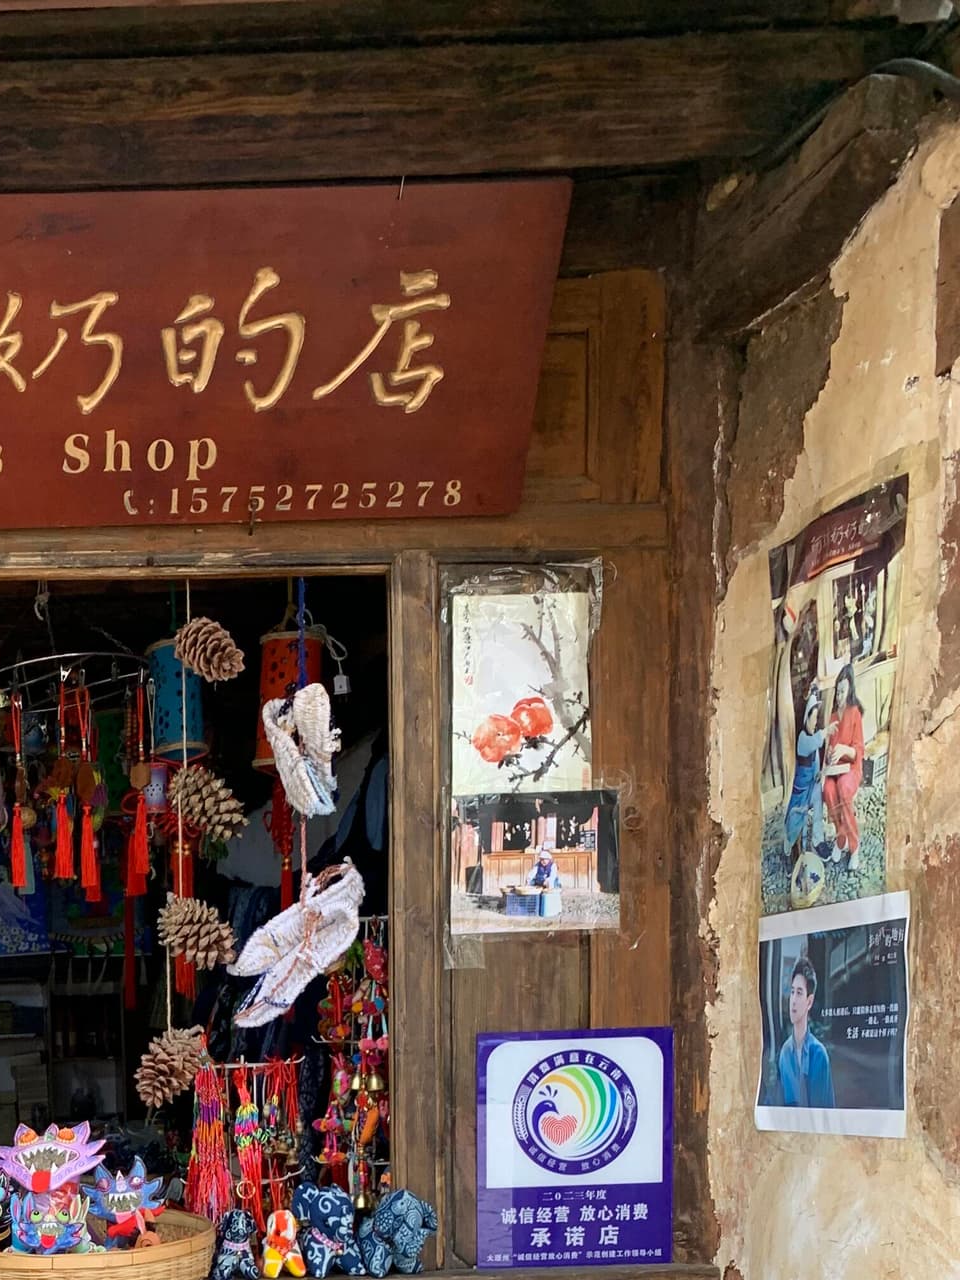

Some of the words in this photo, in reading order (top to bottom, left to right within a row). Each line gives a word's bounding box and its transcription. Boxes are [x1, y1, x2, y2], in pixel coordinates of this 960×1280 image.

[63, 430, 219, 481] Shop
[501, 1205, 571, 1224] 诚信经营
[579, 1203, 649, 1222] 放心消费
